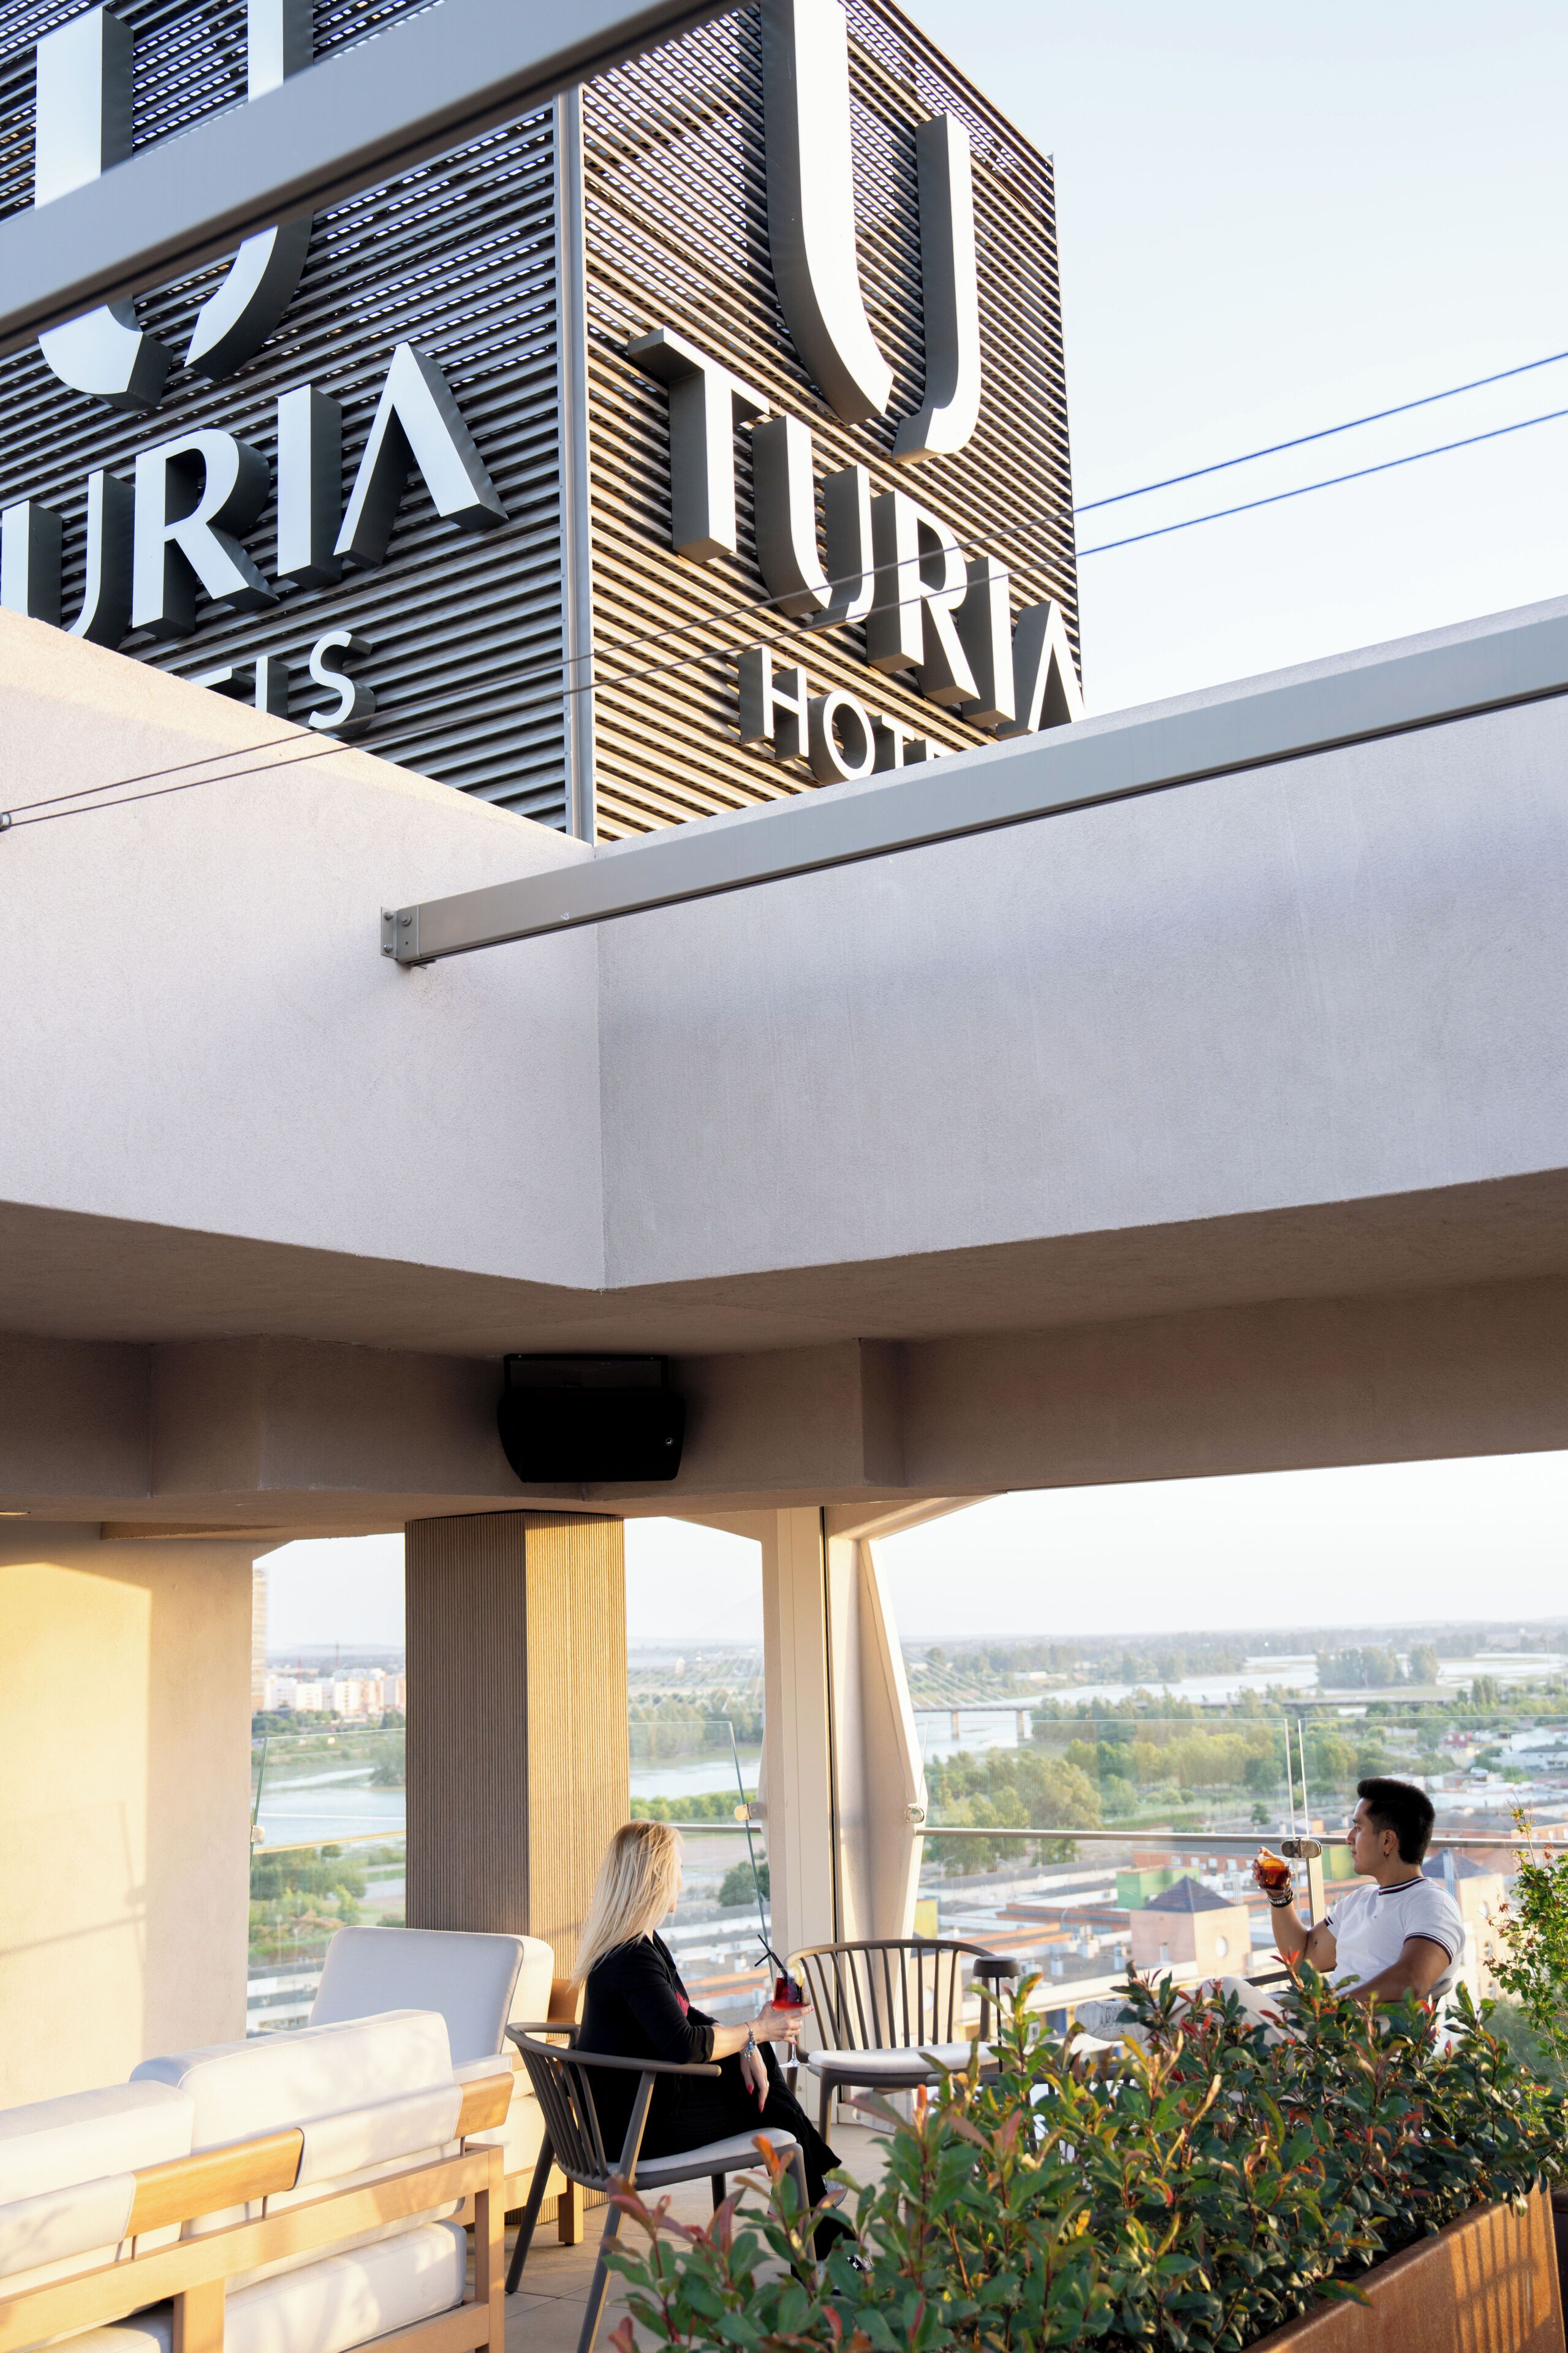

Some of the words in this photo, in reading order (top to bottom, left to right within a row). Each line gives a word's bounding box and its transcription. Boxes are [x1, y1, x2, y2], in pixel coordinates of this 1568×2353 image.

[790, 0, 981, 455] U
[662, 326, 1086, 733] TURIA
[761, 645, 960, 781] HOT
